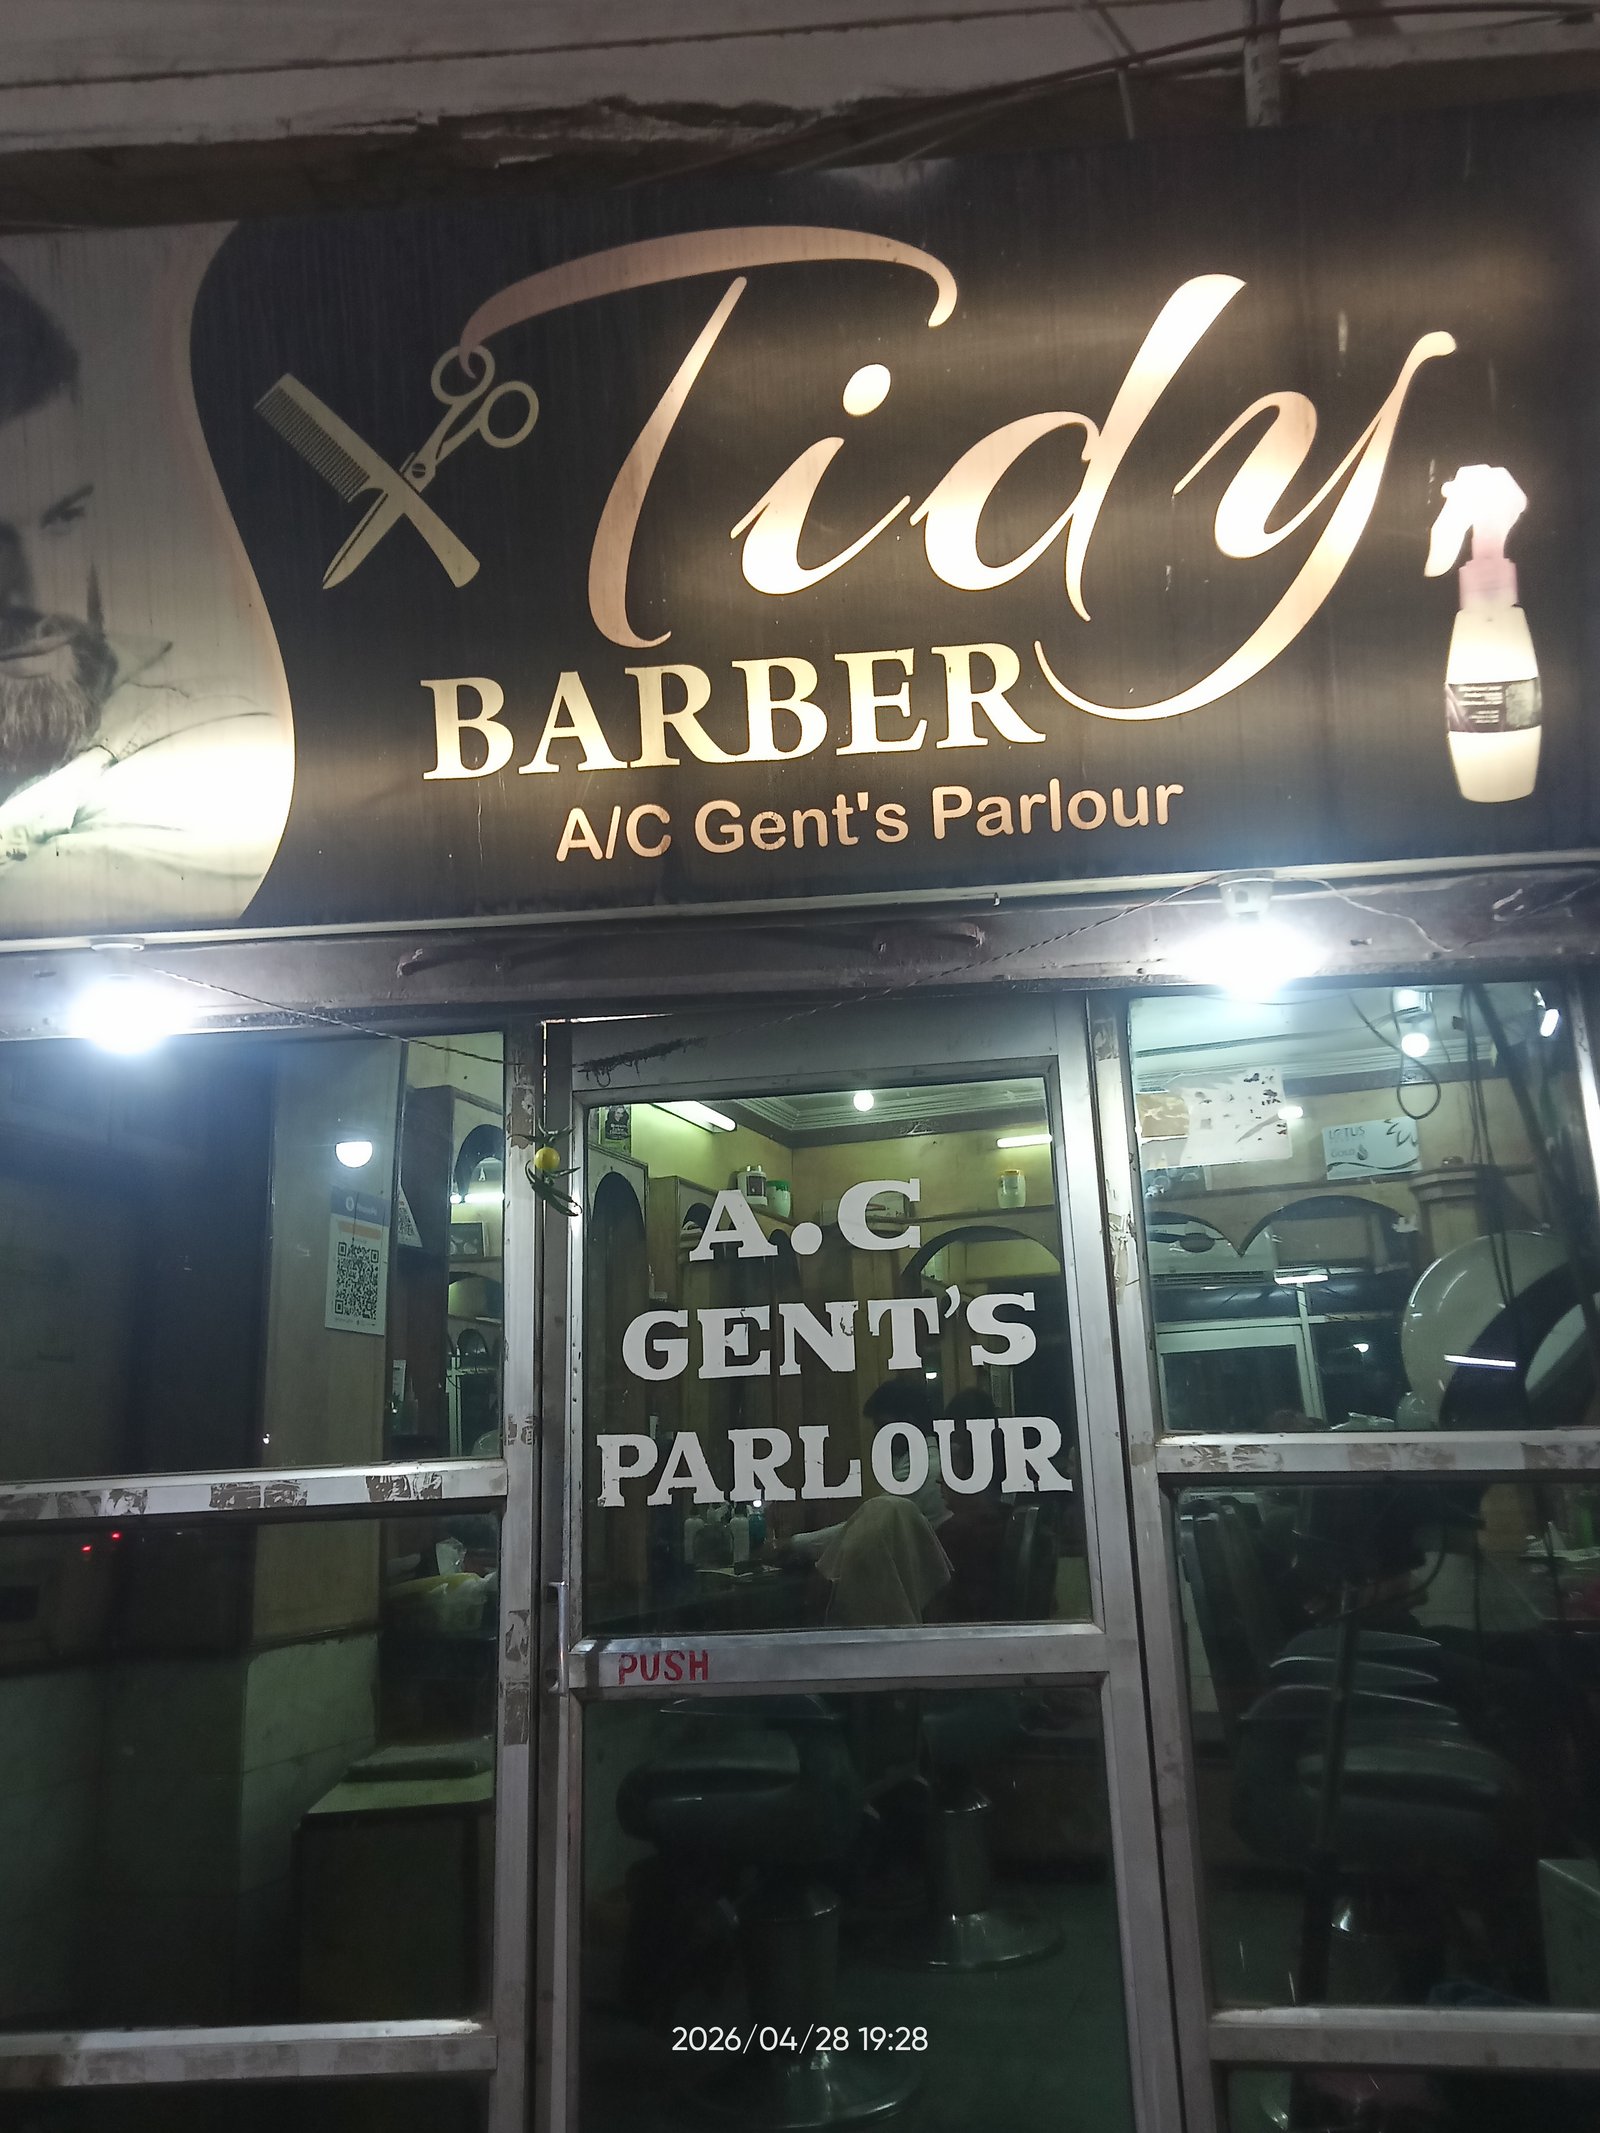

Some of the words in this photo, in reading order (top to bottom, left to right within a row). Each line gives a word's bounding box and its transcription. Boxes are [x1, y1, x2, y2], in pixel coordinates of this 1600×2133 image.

[459, 225, 1458, 721] Tidy
[419, 640, 1047, 782] BARBER
[555, 804, 673, 862] A/C
[694, 791, 910, 855] Gent's
[932, 778, 1185, 841] Parlour
[688, 1177, 922, 1262] A.C
[621, 1284, 1038, 1382] GENT'S
[596, 1415, 1074, 1508] PARLOUR
[618, 1649, 709, 1686] PUSH
